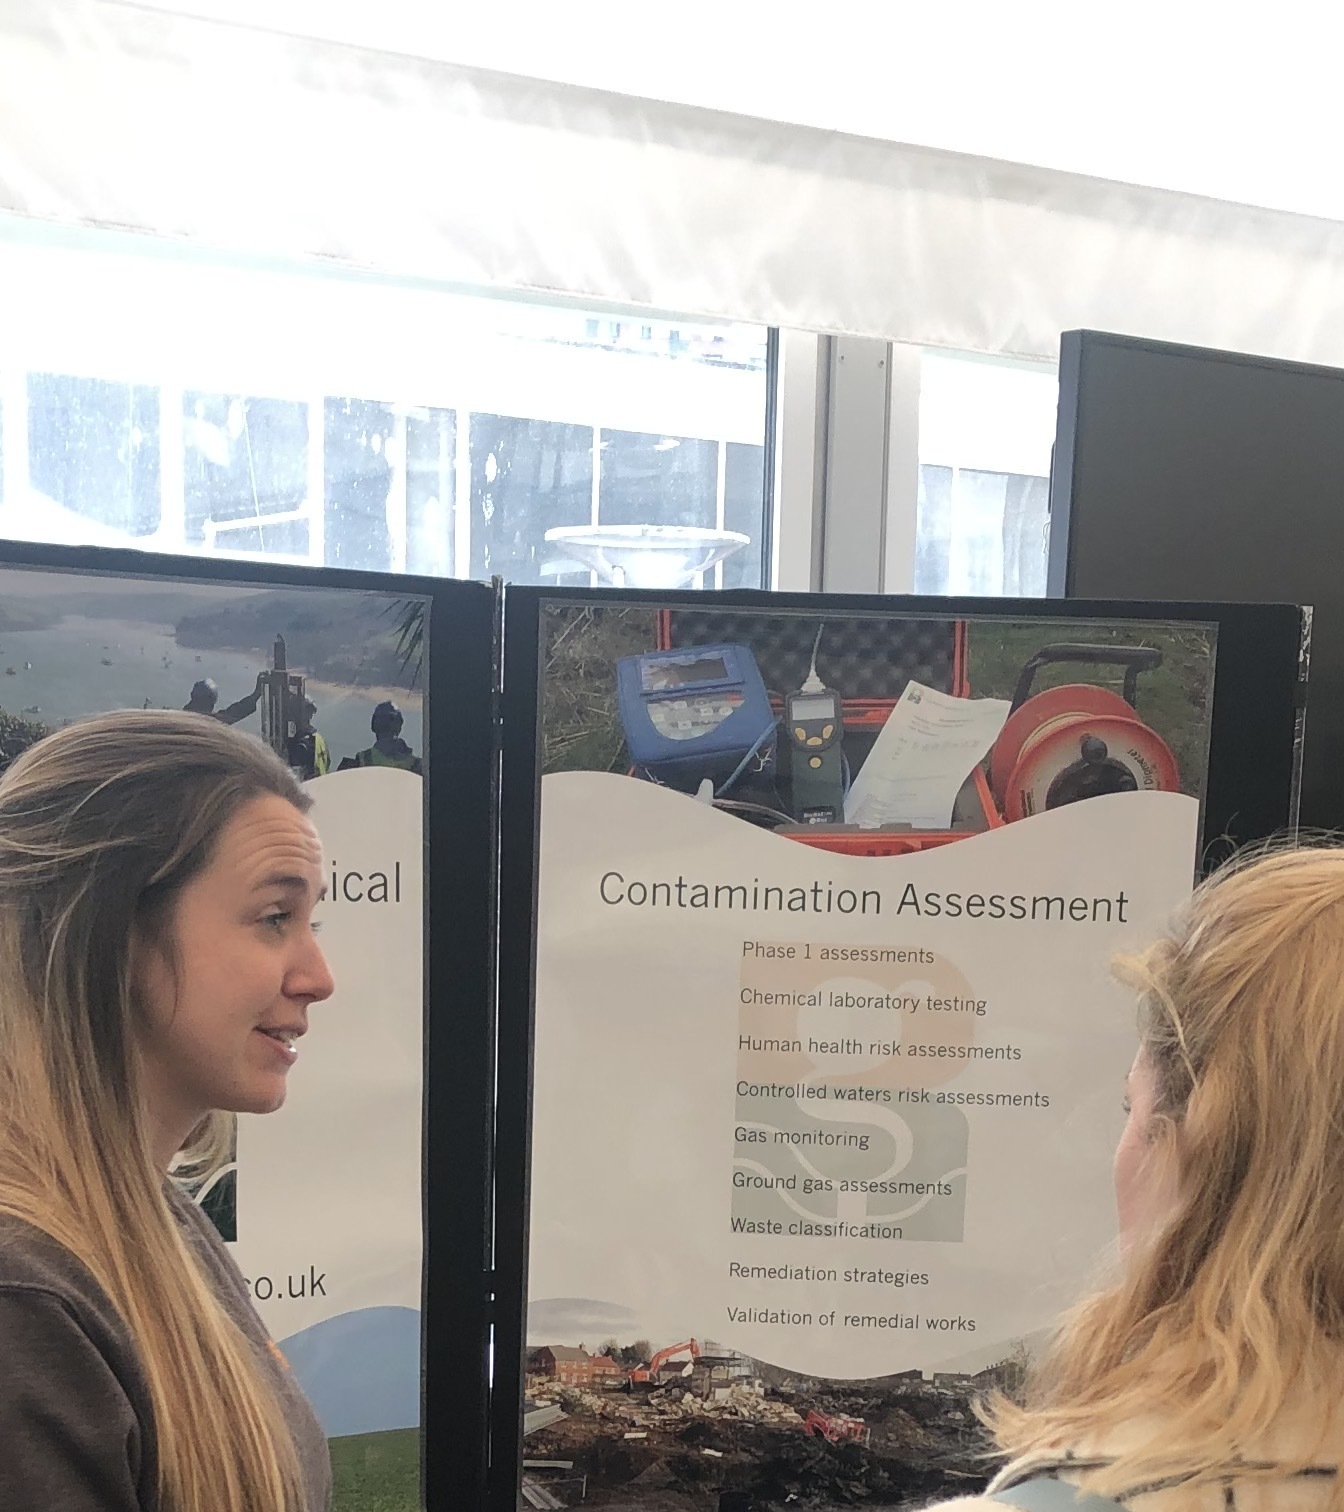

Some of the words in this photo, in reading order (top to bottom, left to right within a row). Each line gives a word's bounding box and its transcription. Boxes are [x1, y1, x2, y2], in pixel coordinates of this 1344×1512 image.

[600, 872, 880, 914] Contamination
[897, 884, 1128, 922] Assessment
[743, 941, 795, 958] Phase
[805, 944, 811, 959] 1
[820, 948, 934, 963] assessments
[741, 988, 821, 1006] Chemical
[830, 992, 920, 1013] laboratory
[927, 996, 987, 1016] testing
[739, 1035, 801, 1052] Human
[809, 1038, 862, 1054] health
[870, 1041, 901, 1056] risk
[908, 1045, 1021, 1060] assessments
[737, 1081, 826, 1099] Controlled
[834, 1086, 891, 1101] waters
[899, 1088, 929, 1103] risk
[937, 1092, 1049, 1107] assessments
[735, 1127, 766, 1142] Gas
[774, 1130, 870, 1150] monitoring
[733, 1172, 796, 1189] Ground
[803, 1179, 832, 1194] gas
[840, 1180, 951, 1195] assessments
[731, 1217, 782, 1234] Waste
[789, 1220, 902, 1239] classification
[730, 1262, 836, 1280] Remediation
[844, 1268, 928, 1287] strategies
[728, 1307, 811, 1324] Validation
[819, 1311, 835, 1326] of
[845, 1314, 918, 1328] remedial
[926, 1316, 975, 1331] works
